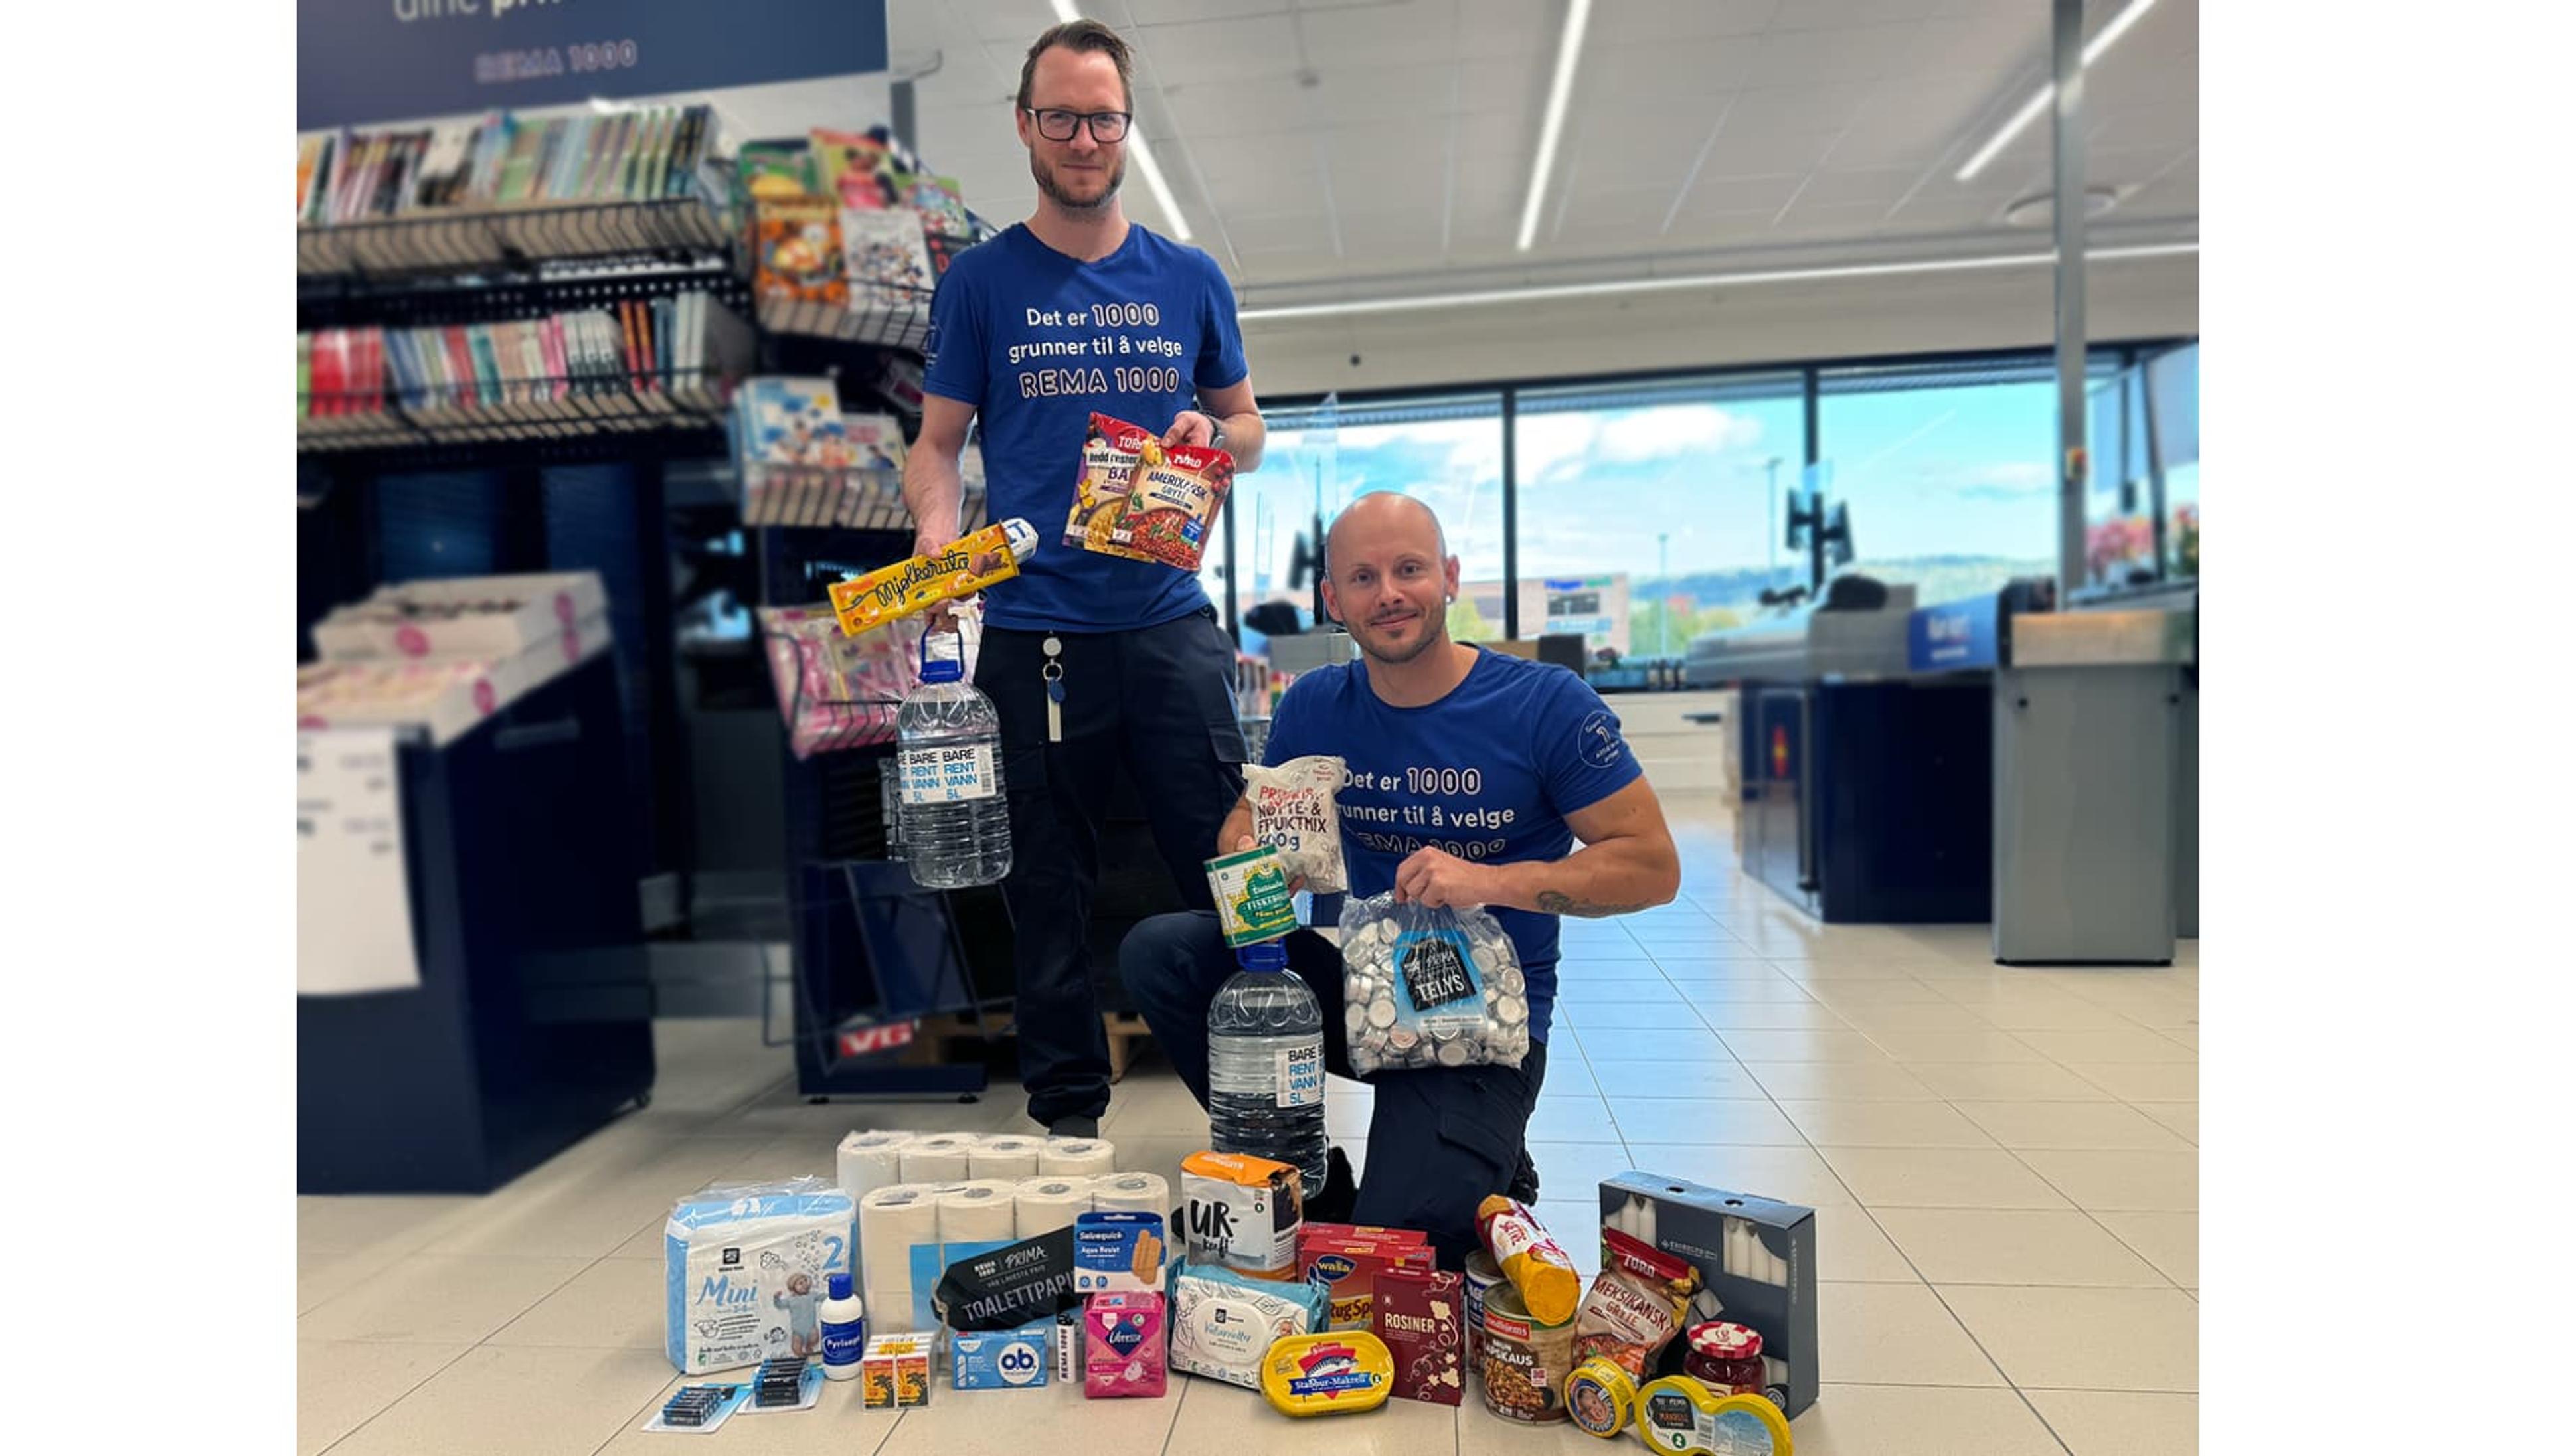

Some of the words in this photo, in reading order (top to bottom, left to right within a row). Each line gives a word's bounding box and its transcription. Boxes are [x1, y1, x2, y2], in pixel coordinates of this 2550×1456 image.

[568, 39, 638, 72] 1000
[1027, 308, 1062, 326] Det
[1067, 312, 1088, 325] er
[1091, 303, 1160, 327] 1000
[1009, 339, 1087, 364] grunner
[1092, 337, 1112, 355] til
[1118, 335, 1130, 354] å
[1136, 336, 1183, 357] velge
[1019, 368, 1108, 398] REMA
[1115, 367, 1179, 393] 1000
[910, 752, 937, 764] BARE
[943, 748, 975, 762] BARE
[911, 765, 938, 776] RENT
[944, 762, 975, 774] RENT
[944, 774, 978, 786] VANN
[1343, 769, 1374, 789] Det
[1380, 775, 1401, 791] er
[1406, 767, 1481, 795] 1000
[1311, 802, 1321, 816] &
[1337, 803, 1398, 822] runner
[1403, 805, 1425, 825] til
[1431, 805, 1443, 826] å
[1450, 807, 1515, 829] velge
[1416, 974, 1464, 1001] TELYS
[847, 1022, 912, 1053] VG
[1289, 1046, 1316, 1062] BARE
[1289, 1062, 1316, 1076] RENT
[1289, 1074, 1317, 1090] VANN
[1191, 1200, 1239, 1238] UR-
[821, 1236, 844, 1271] 2
[1004, 1245, 1049, 1269] PRIMA
[1624, 1255, 1656, 1279] TORO
[695, 1275, 758, 1307] Mini
[961, 1269, 1076, 1321] TOALETTPAPI
[1595, 1277, 1668, 1331] MEKSIKANSK
[1385, 1313, 1435, 1333] ROSINER
